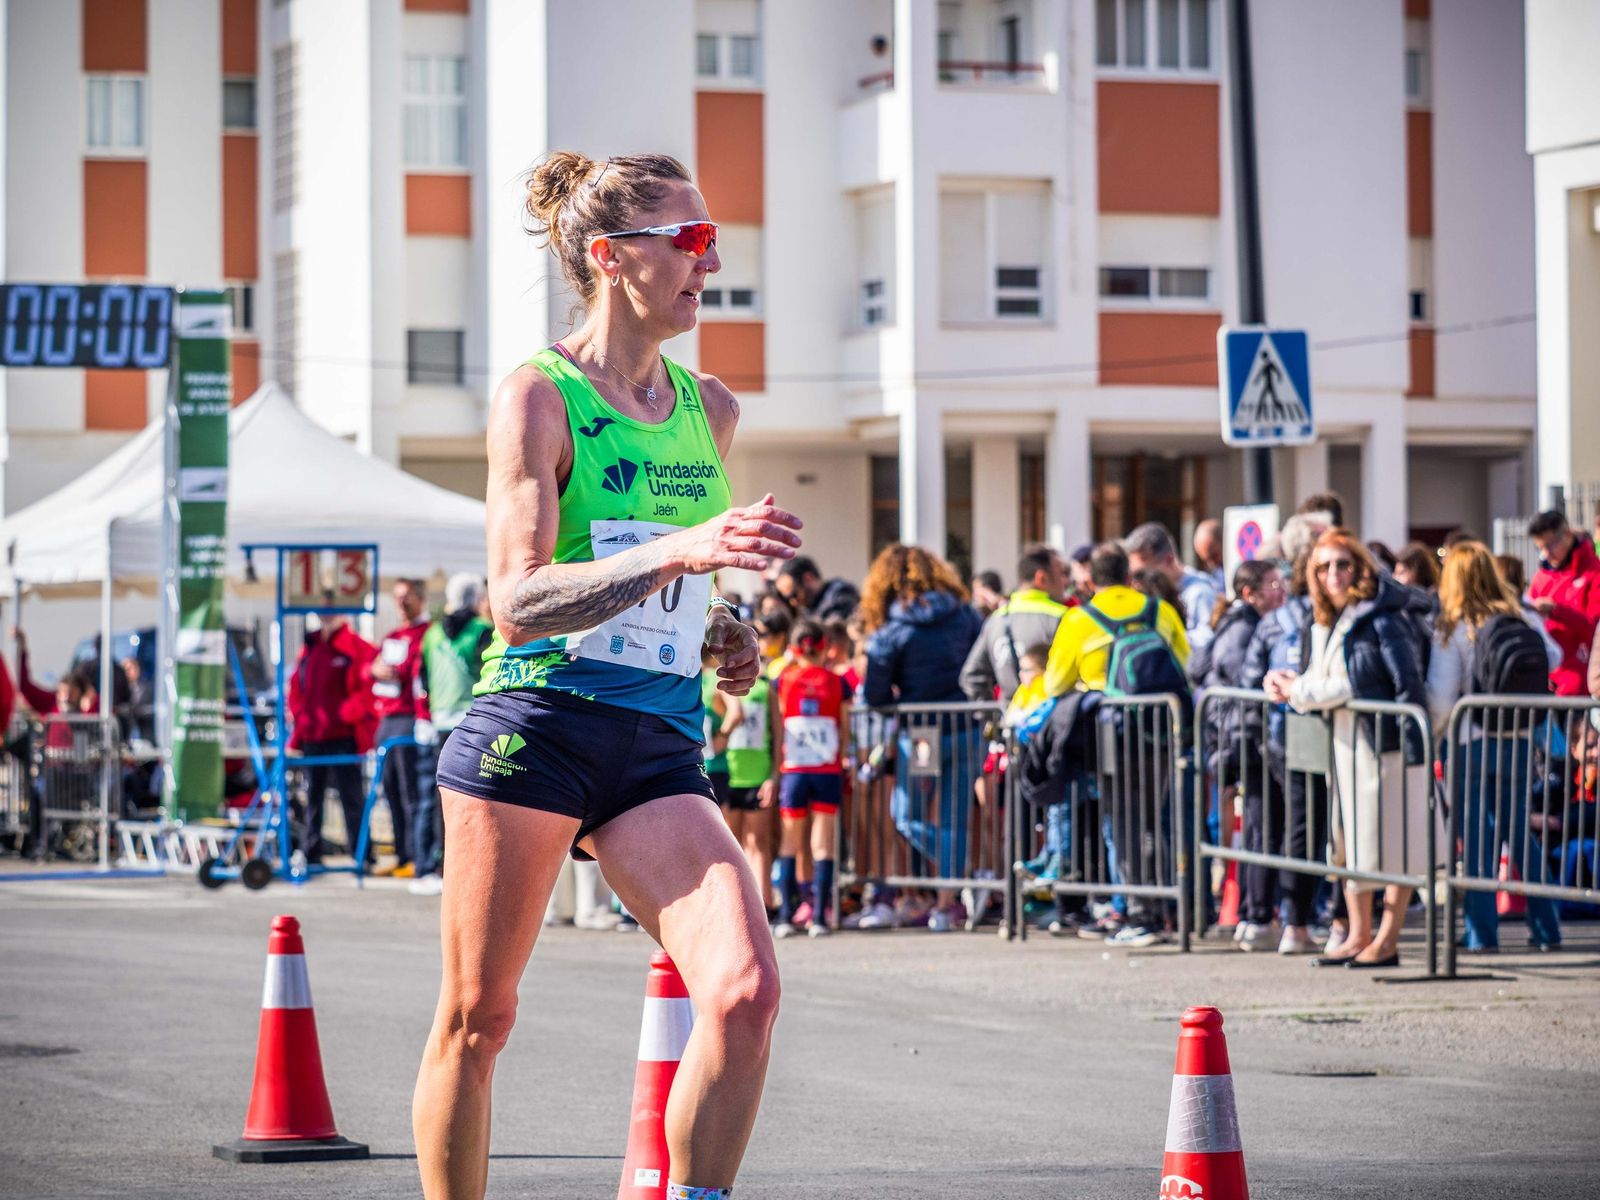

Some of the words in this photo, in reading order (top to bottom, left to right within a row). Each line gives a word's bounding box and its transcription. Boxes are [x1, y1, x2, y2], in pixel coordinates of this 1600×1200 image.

[4, 286, 170, 366] 00:00
[643, 461, 719, 479] Fundación
[648, 480, 707, 502] Unicaja
[653, 503, 678, 516] Jaén
[480, 760, 513, 776] Unicaja
